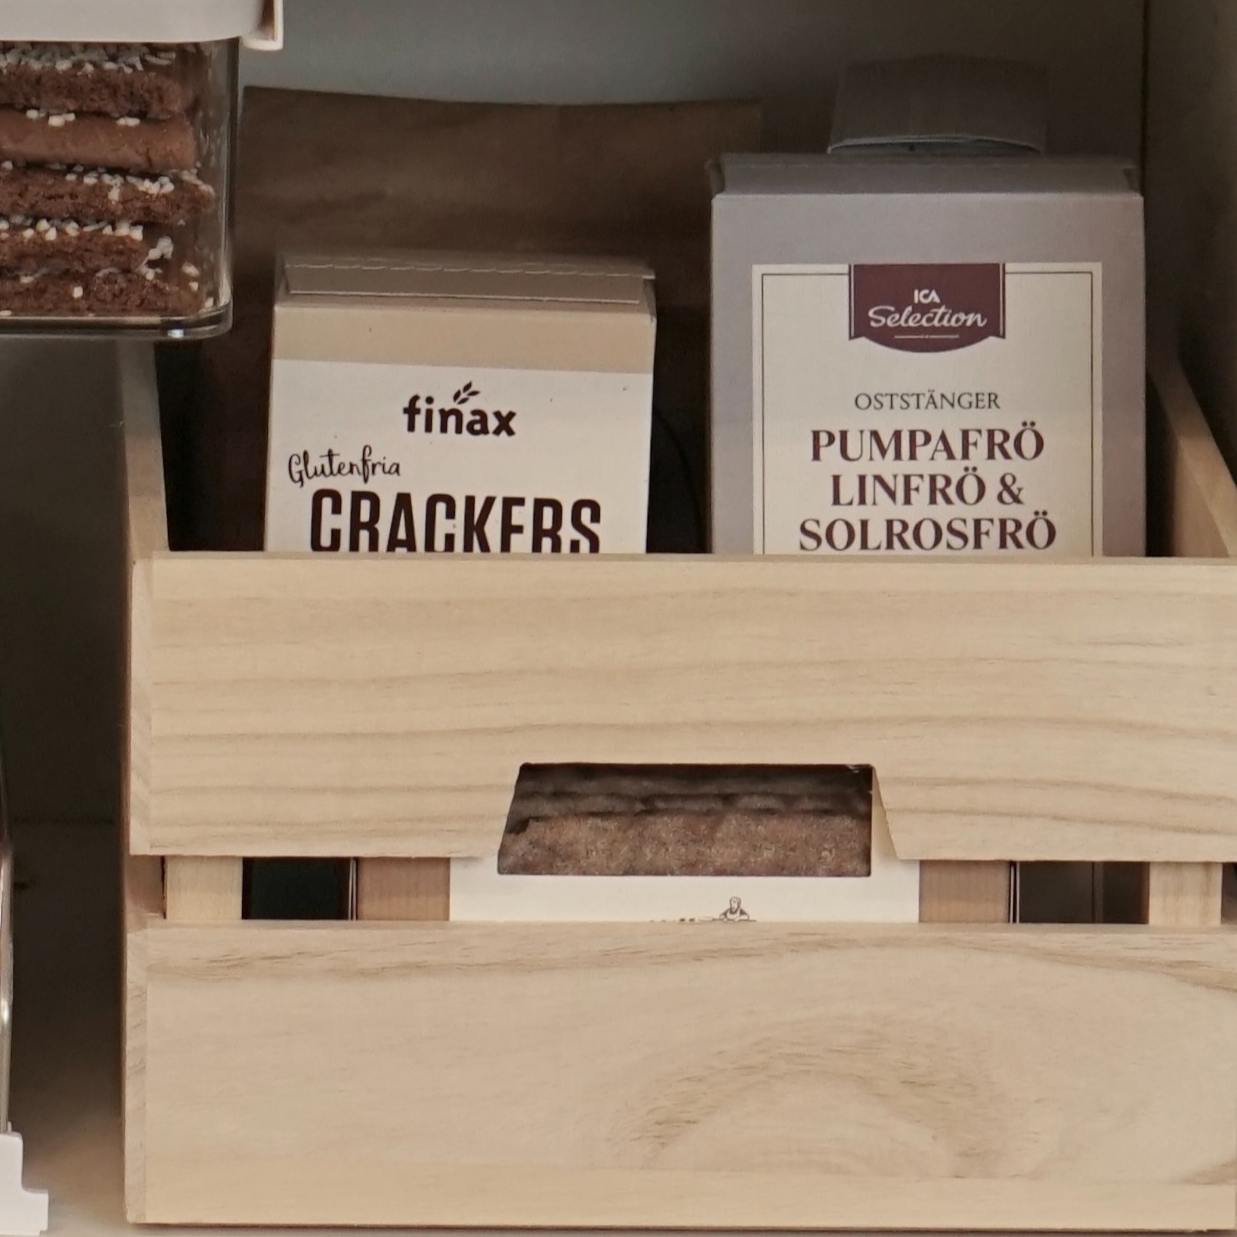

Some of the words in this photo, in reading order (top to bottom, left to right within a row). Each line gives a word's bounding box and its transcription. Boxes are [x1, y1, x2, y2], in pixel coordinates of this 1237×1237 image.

[867, 304, 988, 328] Selection
[913, 288, 941, 304] ICA
[402, 393, 517, 437] finax
[853, 388, 1001, 411] OSTSTÄNGER
[810, 420, 1045, 462] PUMPAFRÖ
[287, 444, 401, 488] Glutenfria
[830, 465, 987, 507] LINFRÖ
[996, 471, 1025, 506] &
[310, 488, 602, 553] CRACKERS
[799, 509, 1057, 552] SOLROSFRÖ
